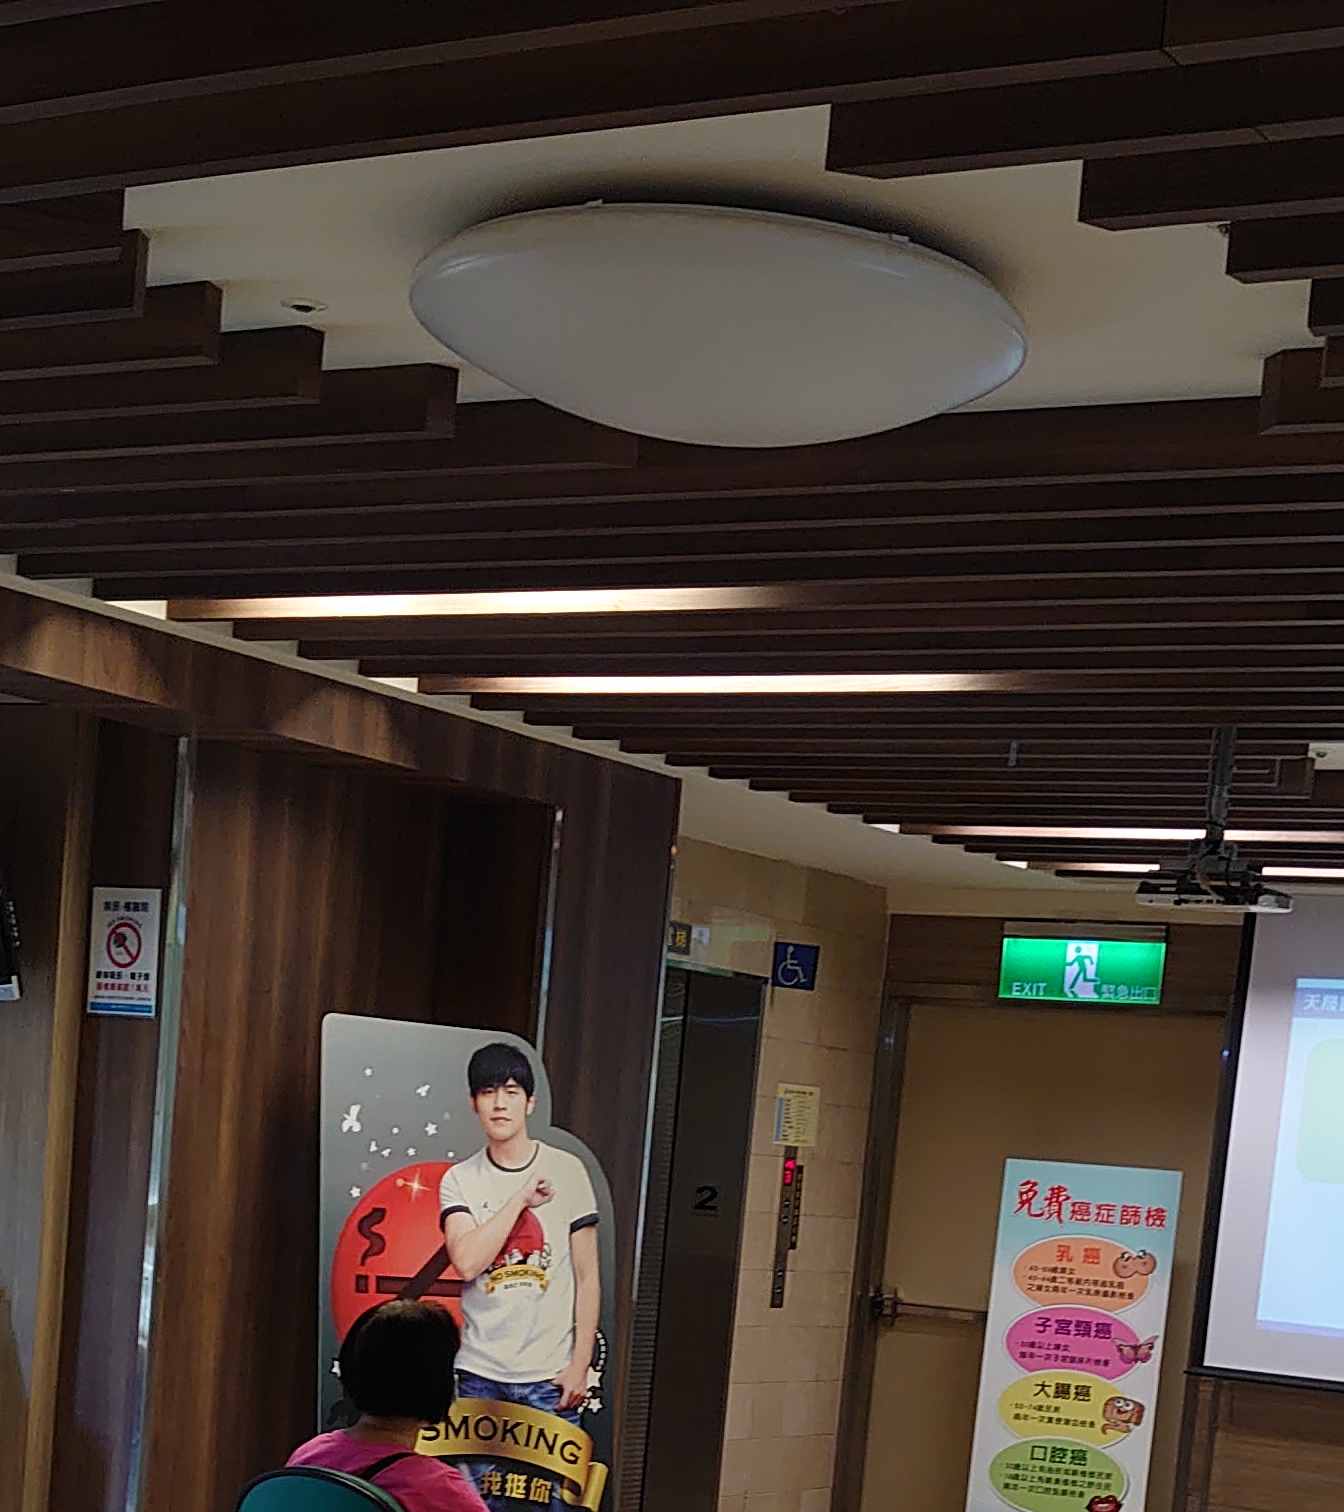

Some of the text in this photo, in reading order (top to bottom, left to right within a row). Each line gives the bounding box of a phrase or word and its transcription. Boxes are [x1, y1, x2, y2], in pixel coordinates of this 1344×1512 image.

[1011, 982, 1047, 996] EXIT
[1101, 985, 1158, 1001] 緊急出口
[693, 1184, 720, 1212] 2
[1035, 1316, 1113, 1340] 子宮頸癌
[1033, 1380, 1093, 1402] 大腸癌
[421, 1415, 583, 1465] SMOKING
[1030, 1445, 1089, 1467] 口腔癌
[480, 1470, 552, 1504] 我挺你
